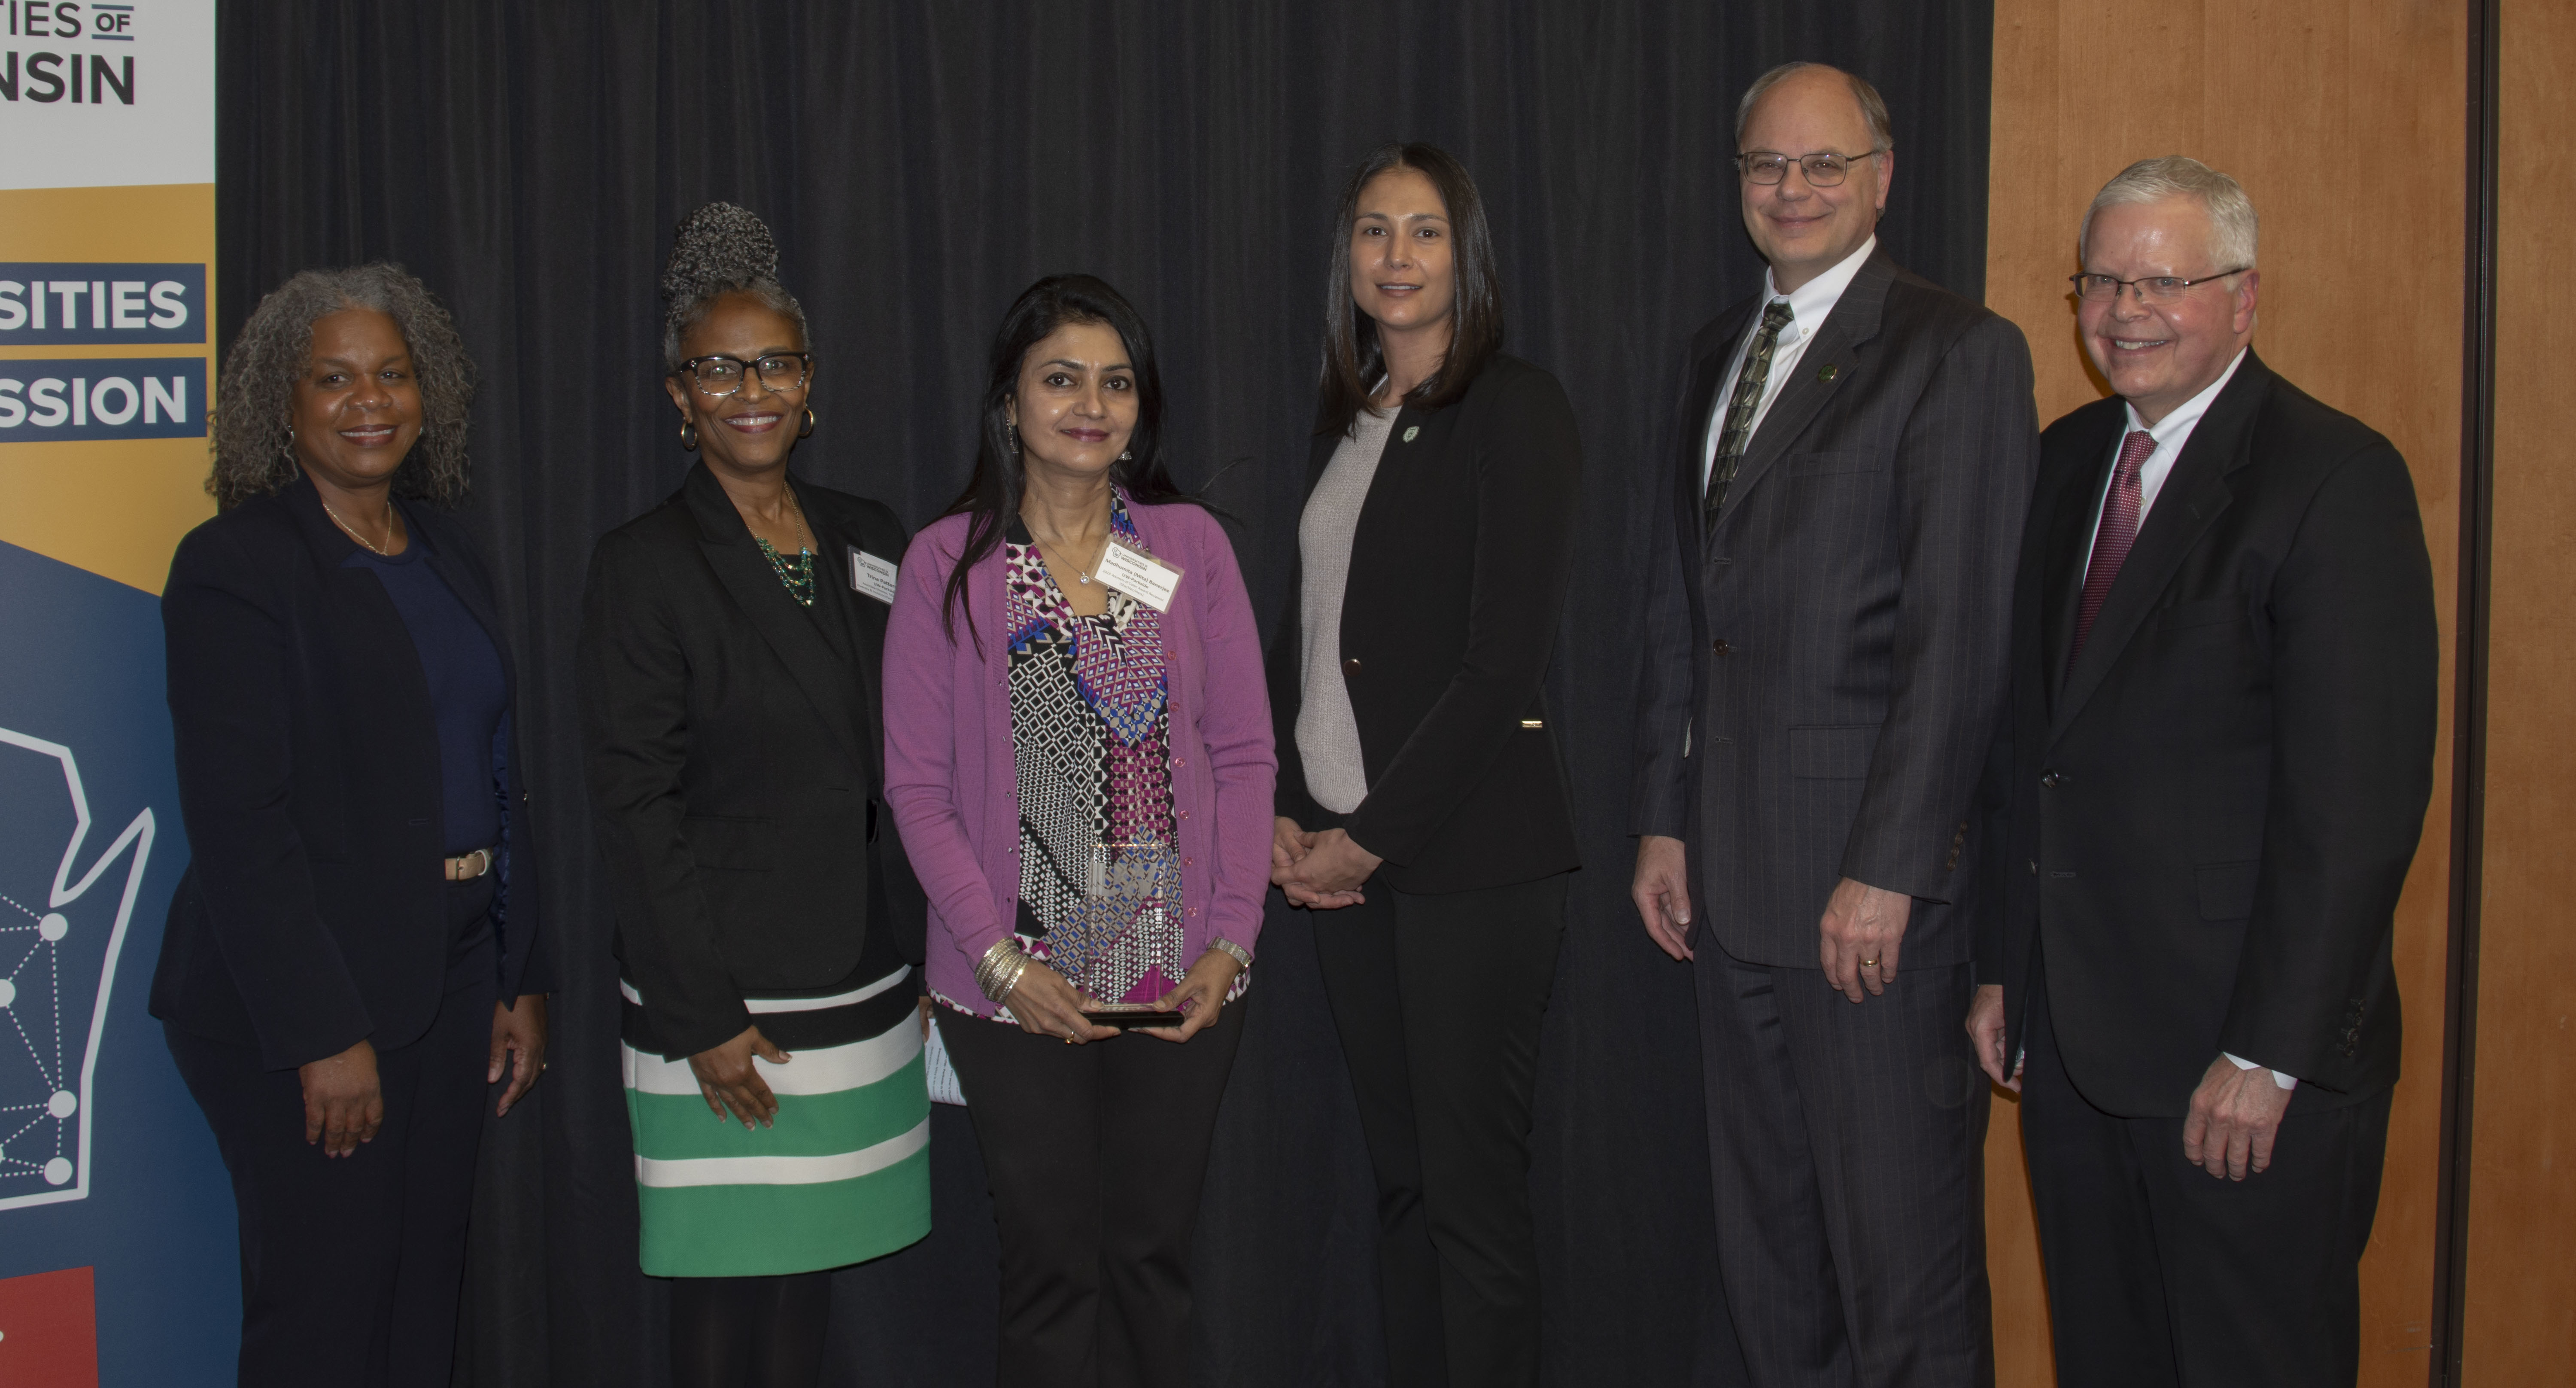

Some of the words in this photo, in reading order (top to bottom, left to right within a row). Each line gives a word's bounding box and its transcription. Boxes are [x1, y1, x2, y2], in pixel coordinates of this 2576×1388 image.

[0, 0, 82, 38] IES
[95, 13, 130, 32] OF
[0, 280, 187, 330] SITIES
[0, 376, 186, 427] SSION
[866, 564, 889, 577] WISCONSIN
[1105, 558, 1133, 575] Madhumita
[1133, 571, 1148, 583] (Mita)
[1148, 579, 1170, 594] Banerjee
[1120, 556, 1147, 571] WISCONSIN
[867, 572, 879, 581] Trina
[880, 578, 895, 588] Patter
[1121, 572, 1149, 589] UW-Parkside
